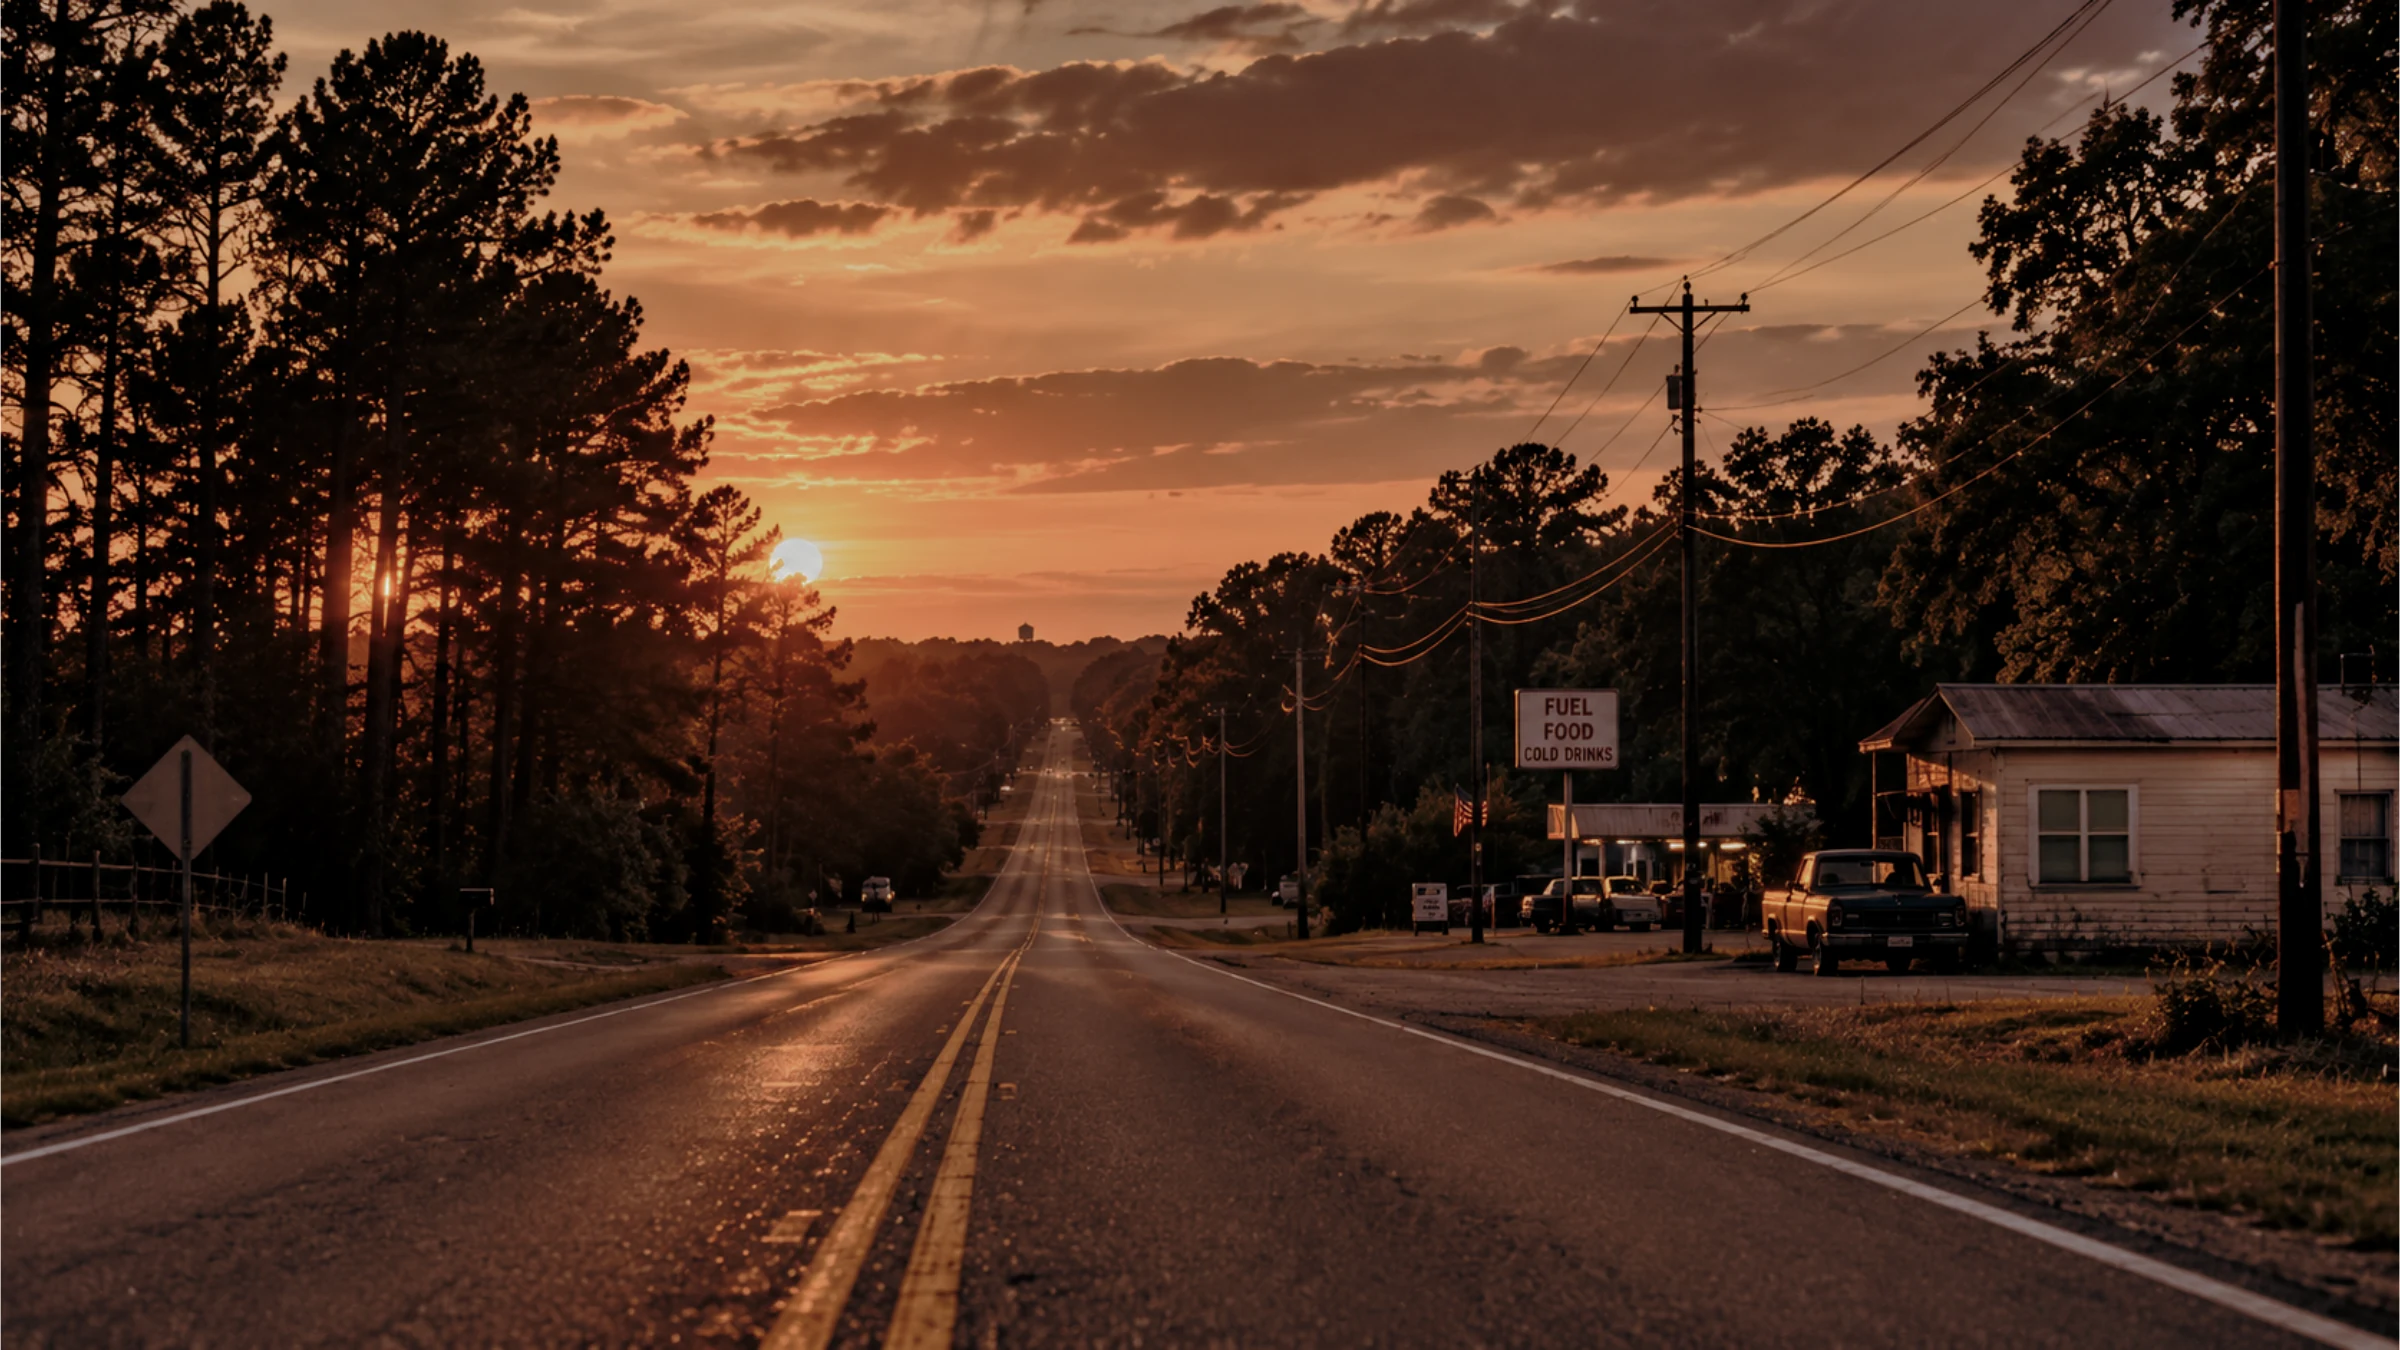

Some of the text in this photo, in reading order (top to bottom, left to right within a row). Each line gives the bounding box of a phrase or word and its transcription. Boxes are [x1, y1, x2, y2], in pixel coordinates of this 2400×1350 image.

[1545, 698, 1593, 716] FUEL
[1544, 722, 1594, 740] FOOD
[1524, 747, 1613, 761] COLD DRINKS
